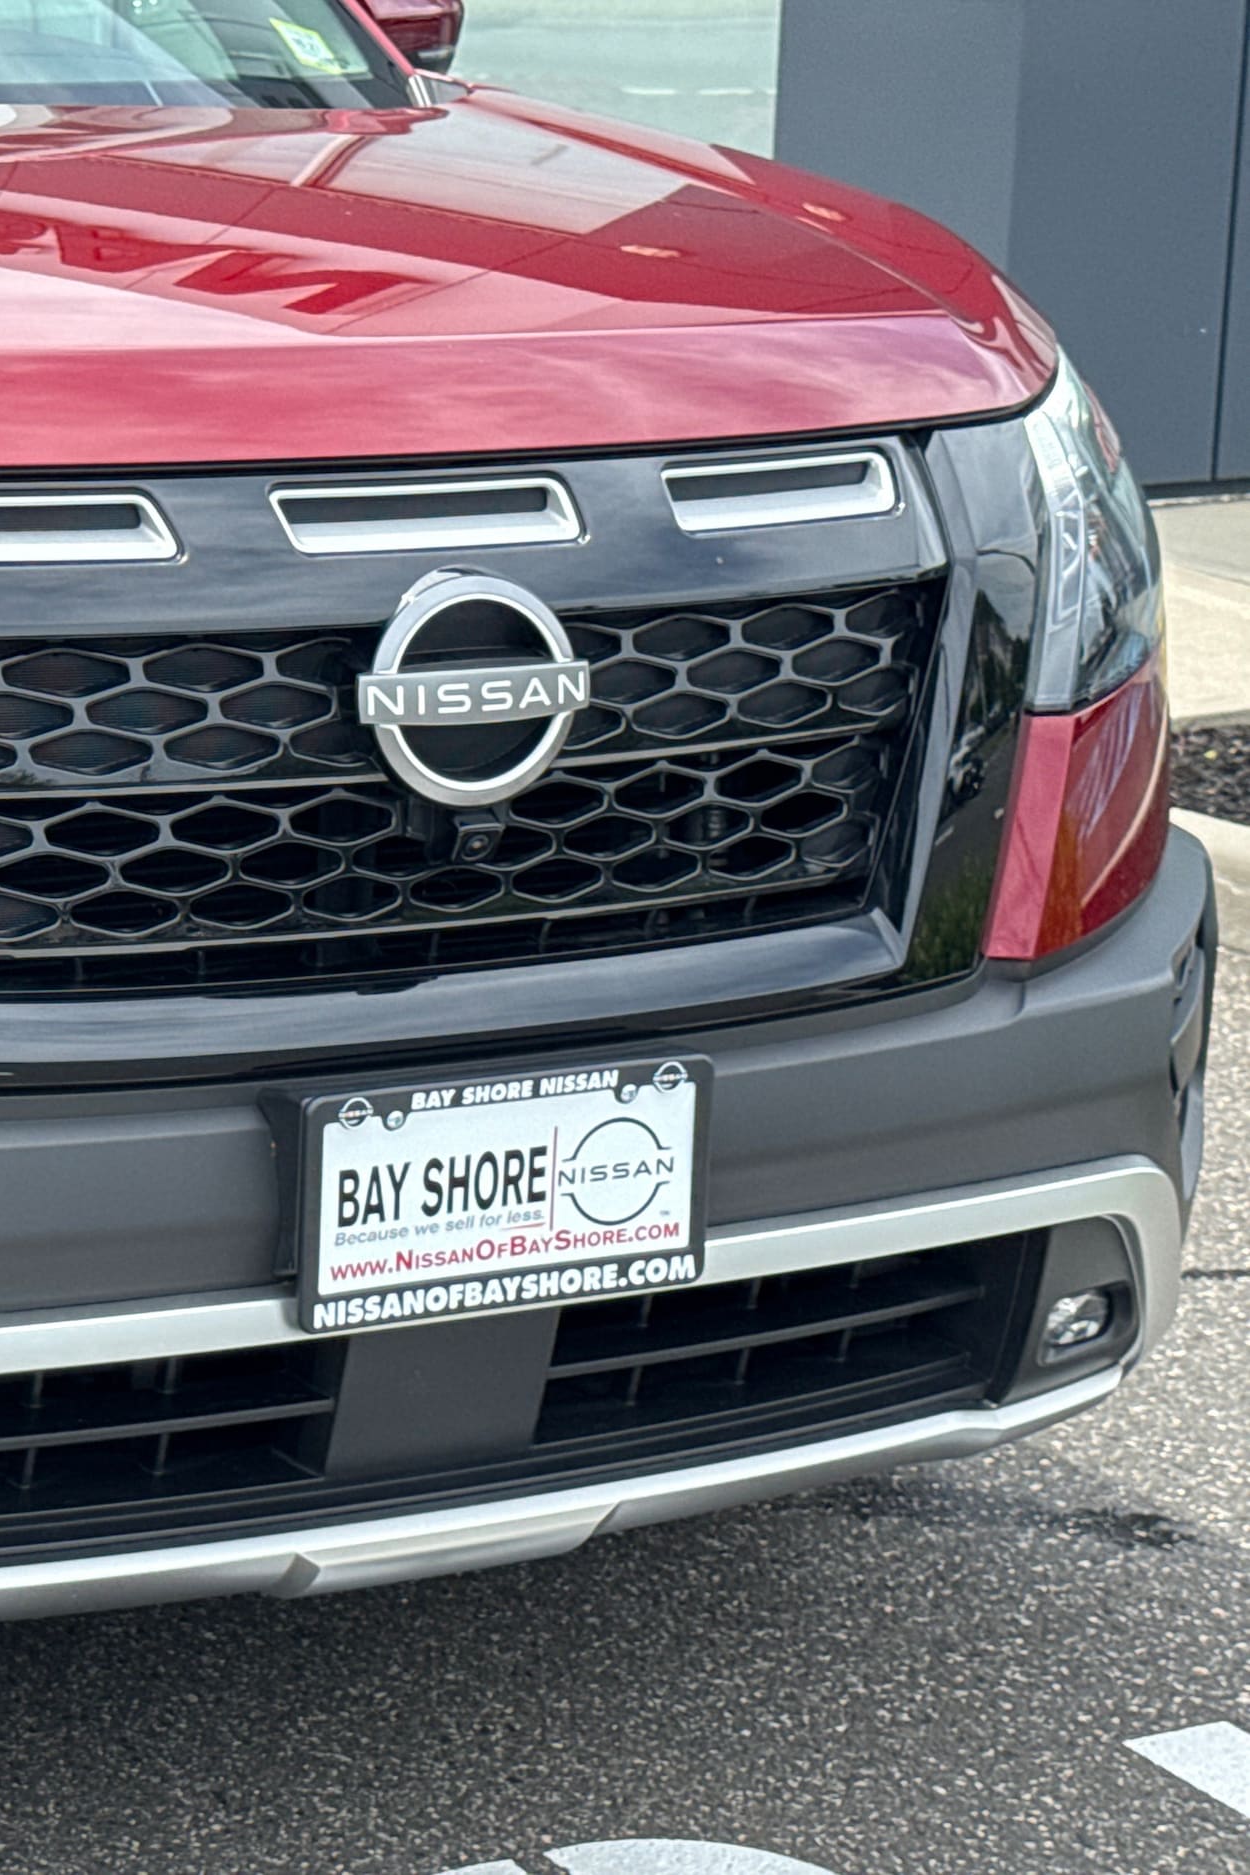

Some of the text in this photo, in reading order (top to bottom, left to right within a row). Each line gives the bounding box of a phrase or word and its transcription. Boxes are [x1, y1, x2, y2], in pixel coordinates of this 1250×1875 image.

[367, 670, 585, 716] NISSAN
[411, 1069, 619, 1110] BAY SHORE NISSAN
[338, 1145, 547, 1228] BAY SHORE
[558, 1156, 674, 1186] NISSAN
[334, 1208, 545, 1247] Because we sell for less.
[313, 1254, 696, 1329] NISSANOFBAYSHORE.COM
